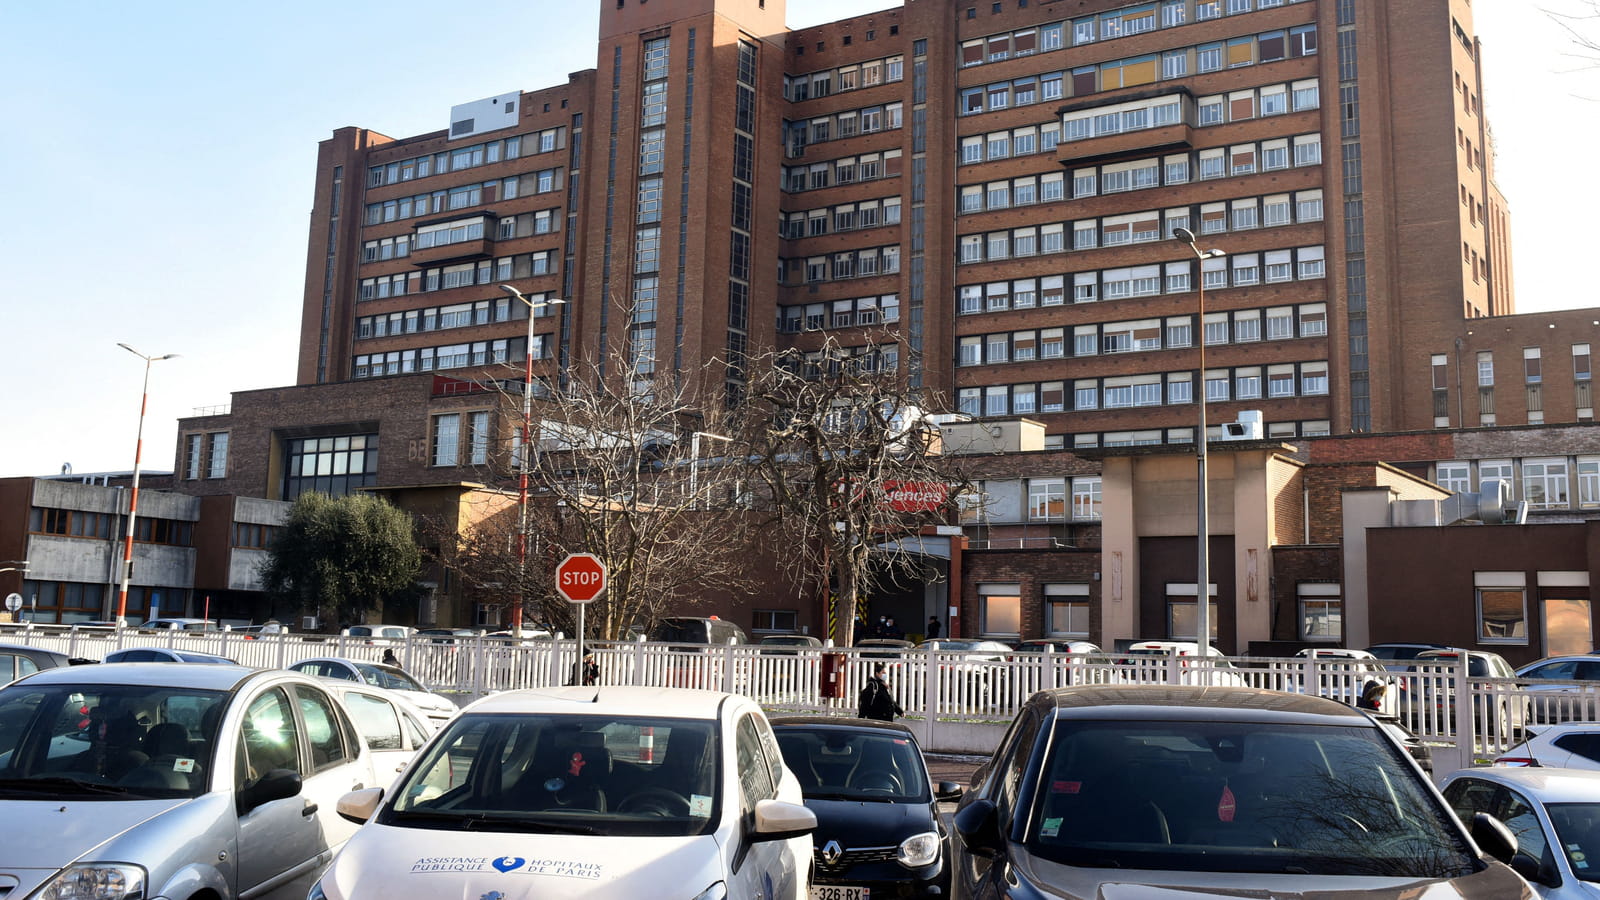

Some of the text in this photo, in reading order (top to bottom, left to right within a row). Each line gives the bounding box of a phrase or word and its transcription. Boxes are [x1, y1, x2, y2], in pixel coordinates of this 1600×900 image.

[562, 571, 600, 585] STOP
[411, 863, 485, 872] PUBLIQUE
[531, 859, 603, 870] HOPITAUX
[527, 865, 601, 878] DE PARIS
